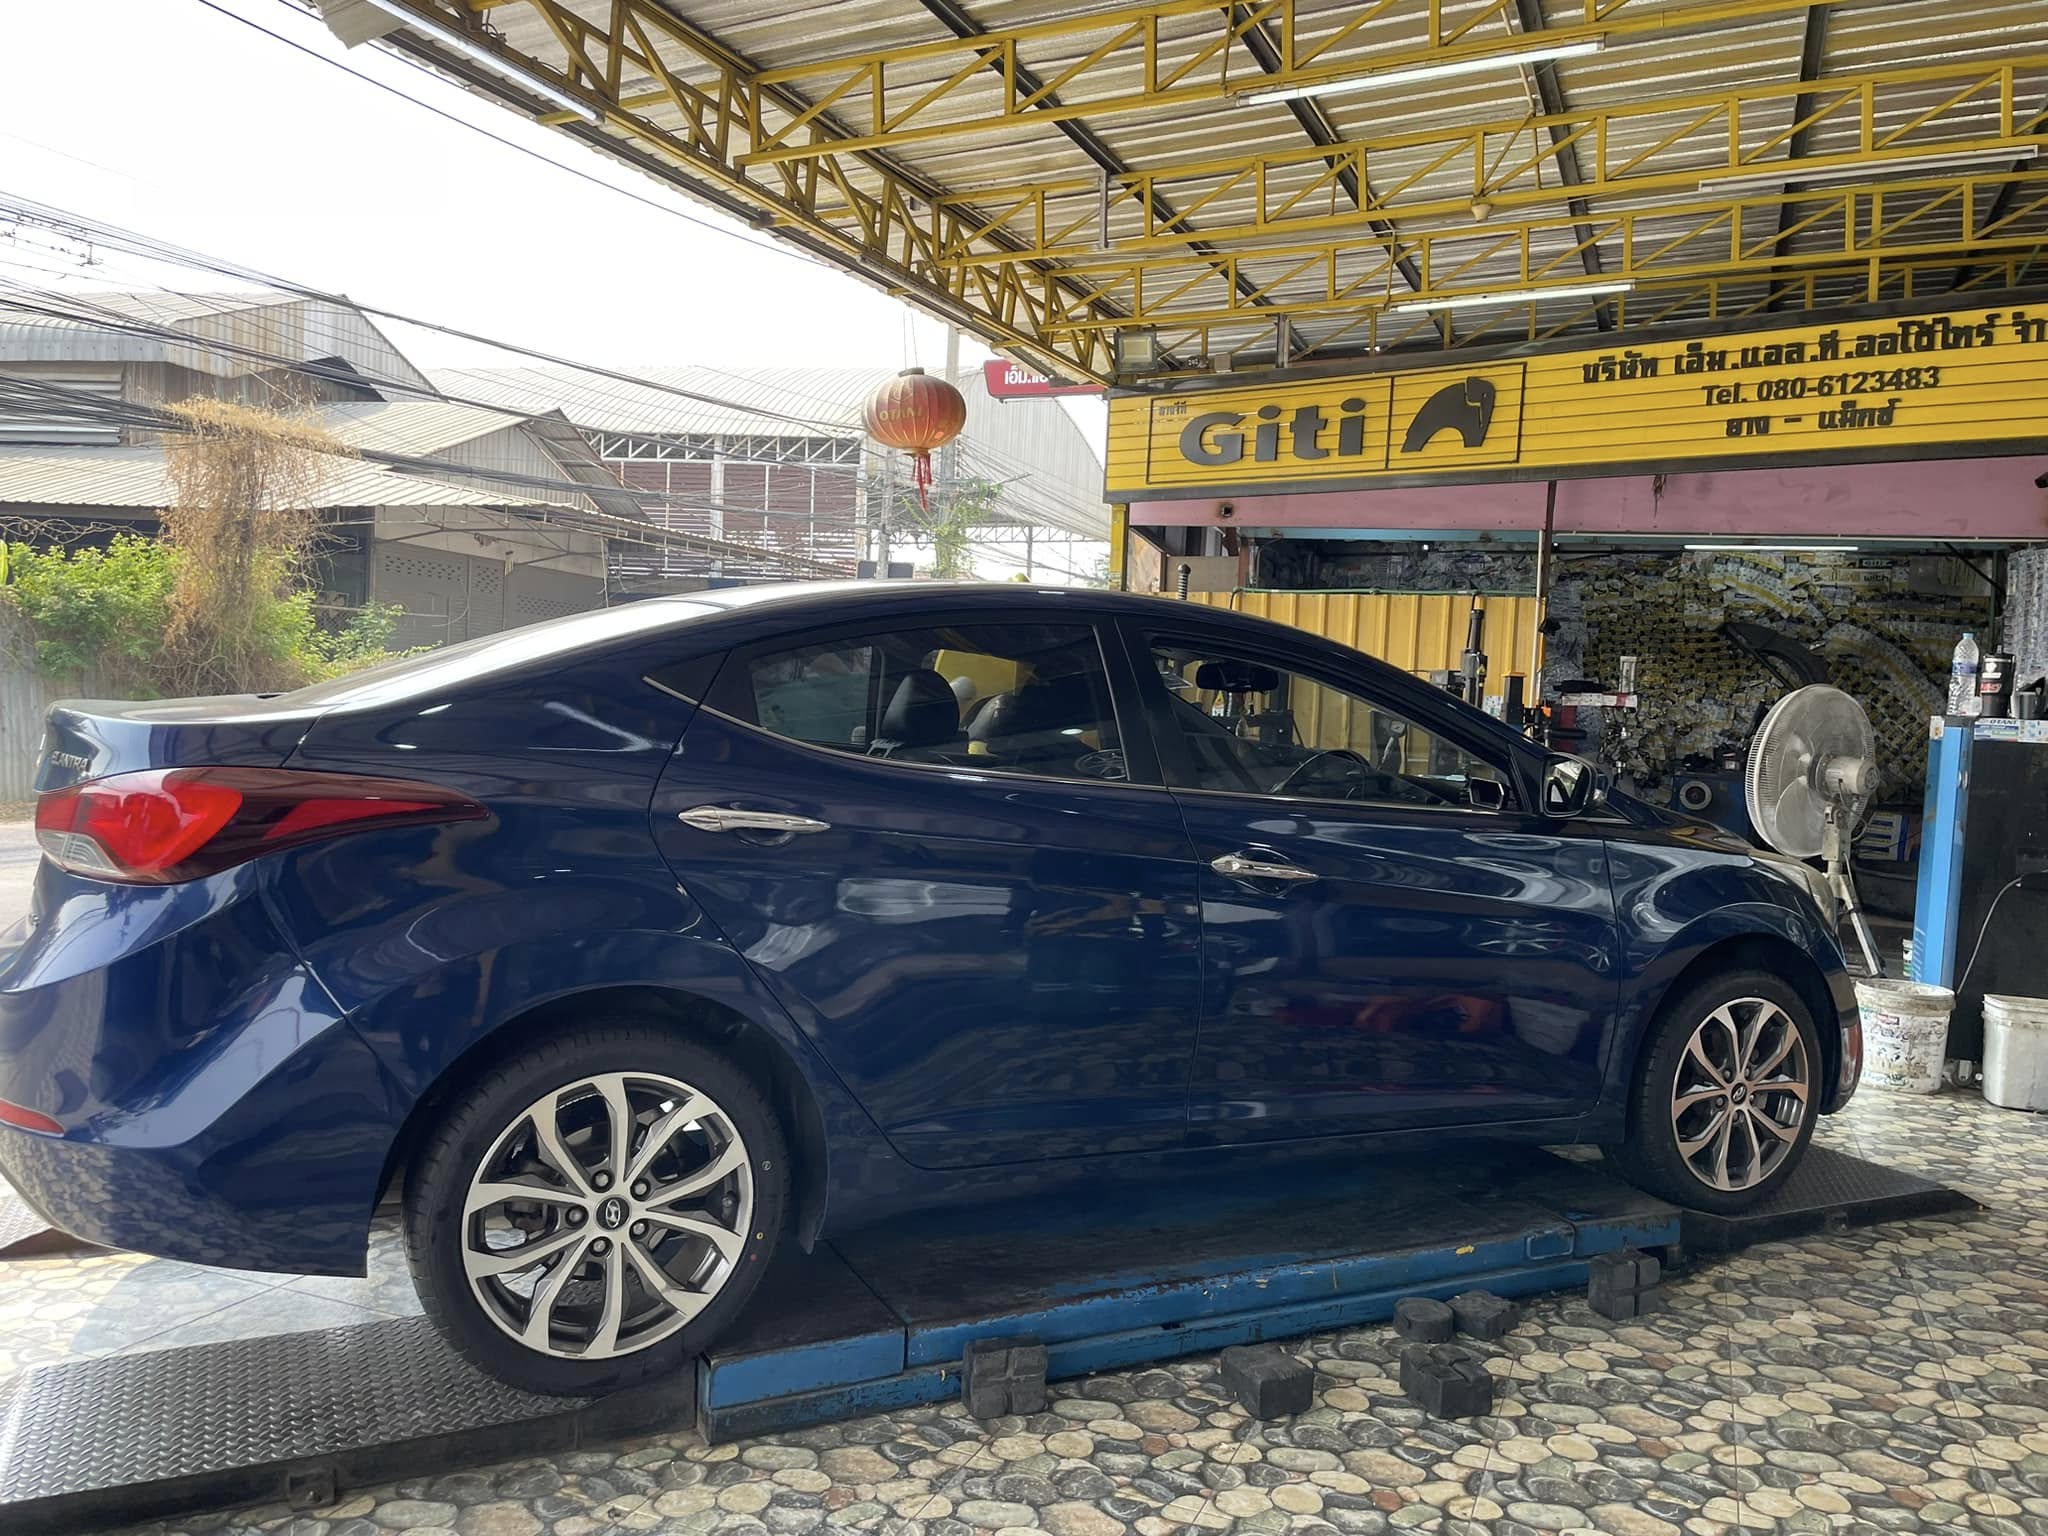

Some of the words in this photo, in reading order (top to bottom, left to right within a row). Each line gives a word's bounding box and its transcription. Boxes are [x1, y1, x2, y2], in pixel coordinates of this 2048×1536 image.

[1583, 350, 1658, 383] บริษัท
[1701, 383, 1748, 406] Tel.
[1757, 366, 1940, 401] 080-6123483
[1179, 398, 1367, 466] Giti
[1726, 416, 1770, 437] ยาง
